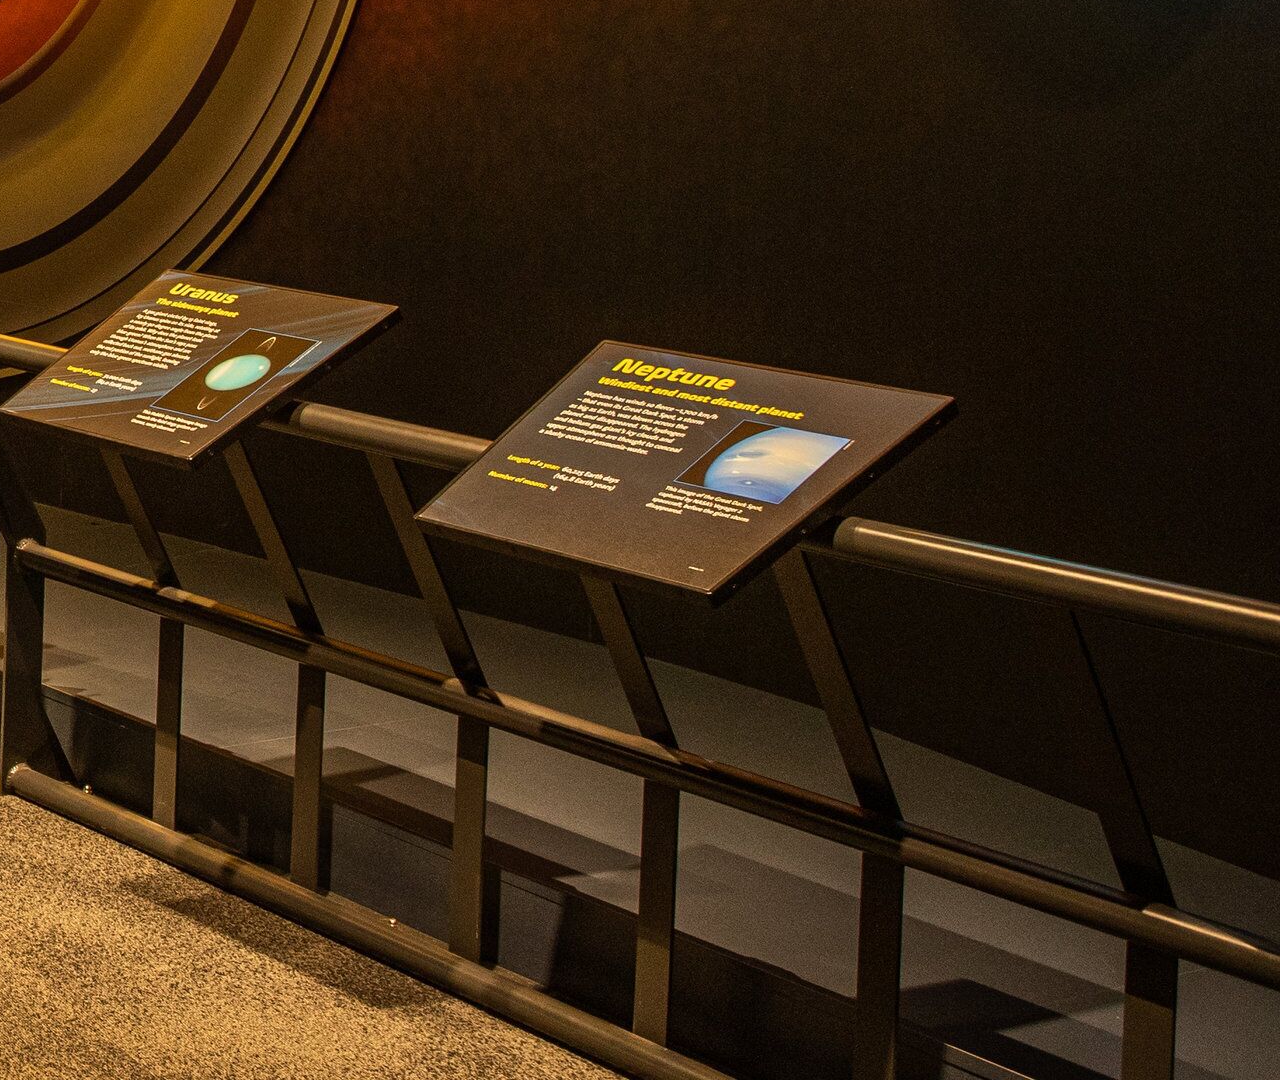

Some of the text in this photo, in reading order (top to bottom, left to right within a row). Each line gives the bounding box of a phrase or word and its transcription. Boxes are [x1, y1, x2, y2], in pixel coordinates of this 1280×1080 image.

[169, 283, 239, 304] Uranus
[156, 298, 239, 318] The sideways planet
[612, 359, 735, 390] Neptune
[598, 377, 804, 420] Windiest and most distant planet
[507, 455, 530, 463] Length
